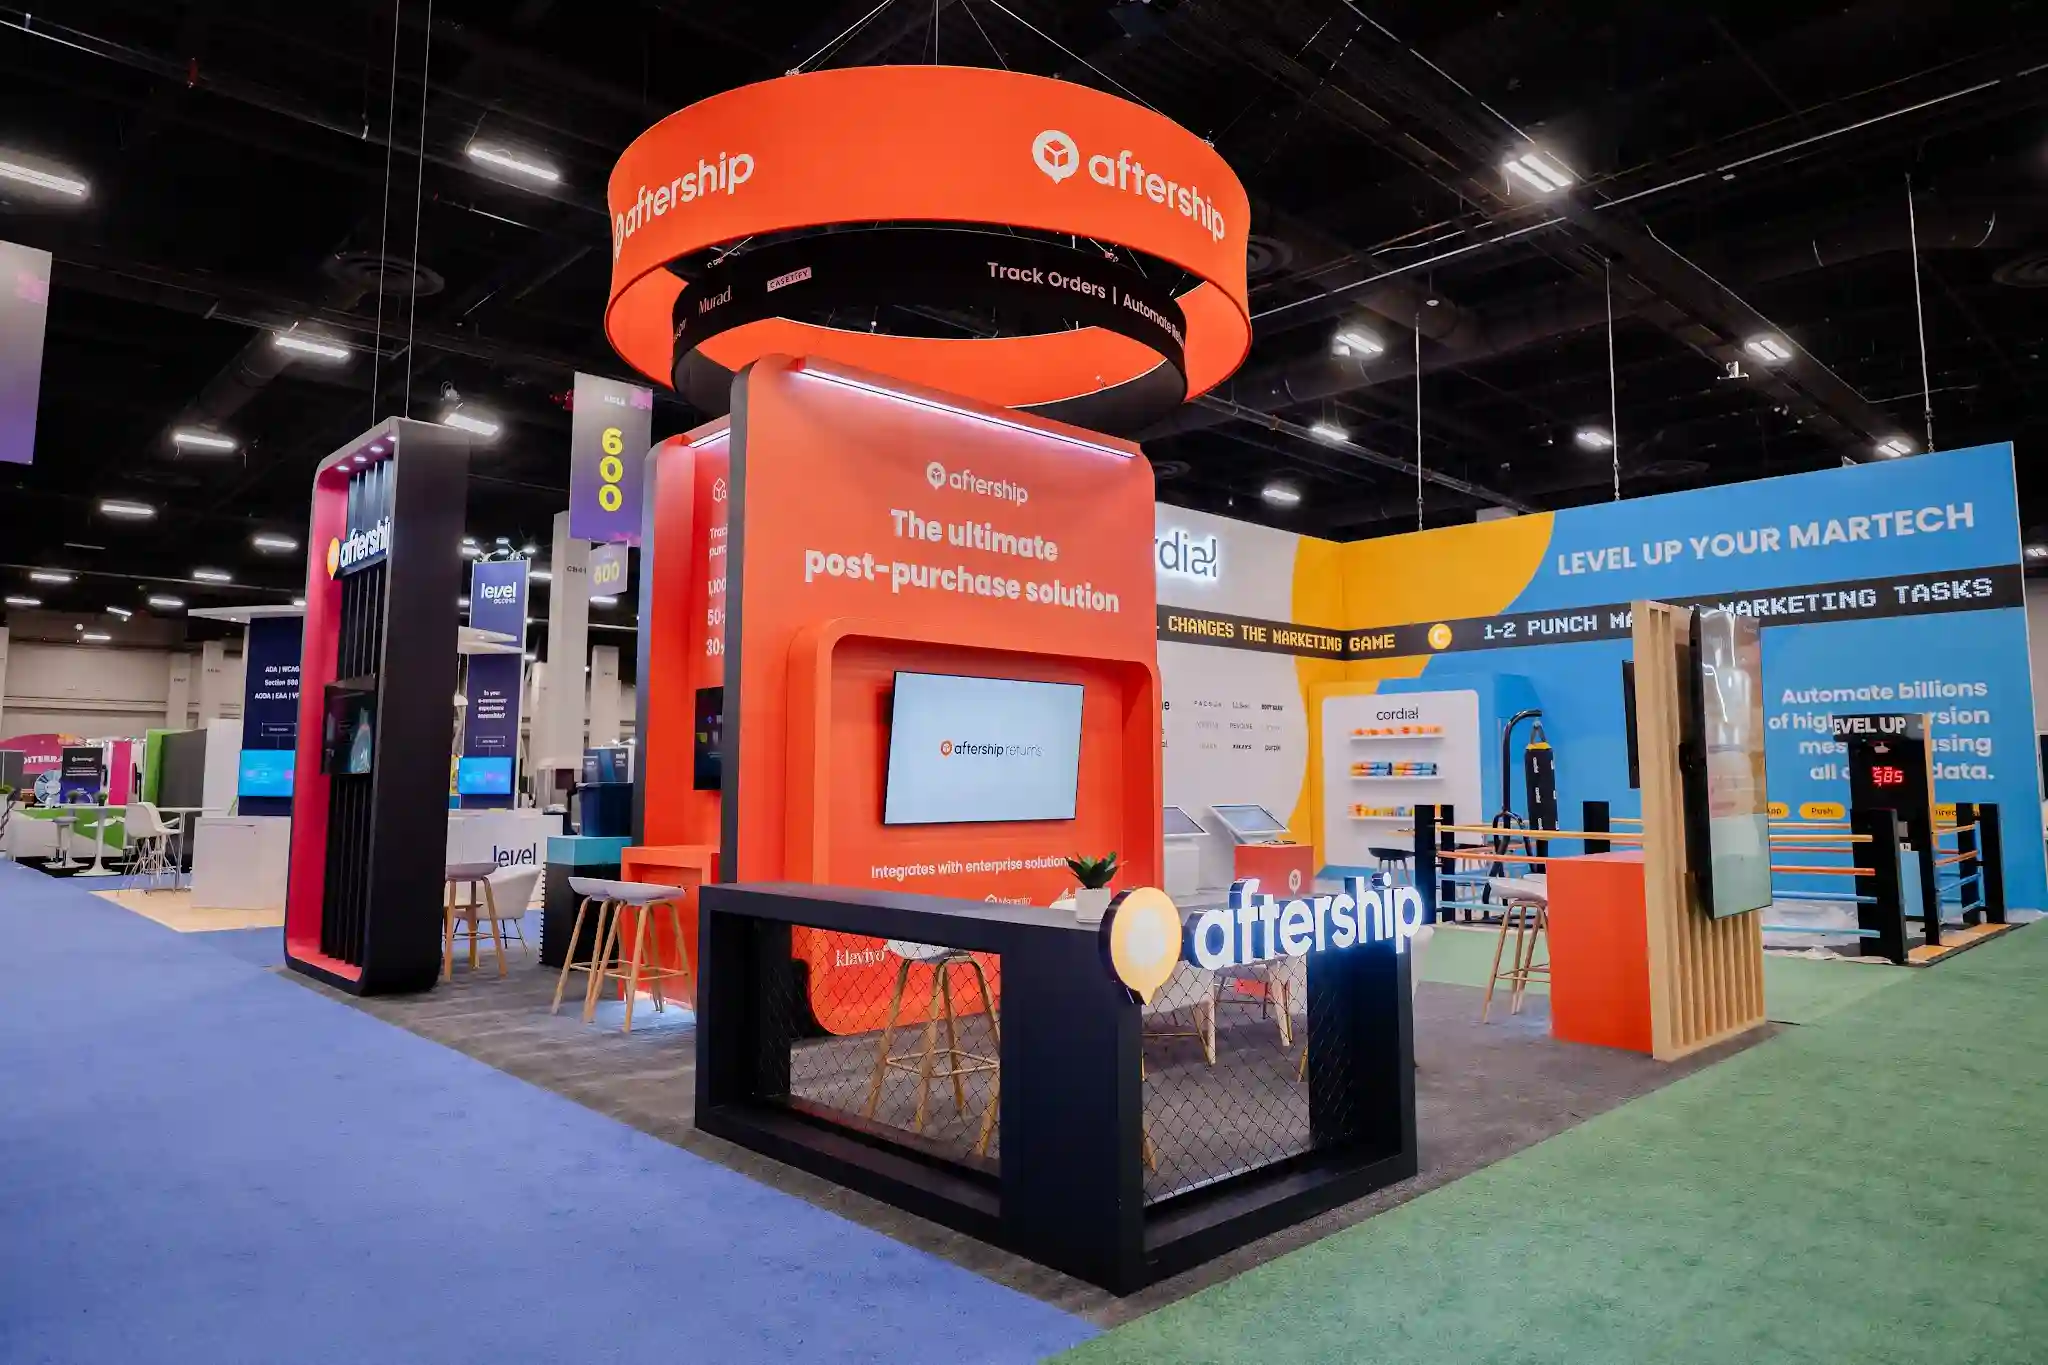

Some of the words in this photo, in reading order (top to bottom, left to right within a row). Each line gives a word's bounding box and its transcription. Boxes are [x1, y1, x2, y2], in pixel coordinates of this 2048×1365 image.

[624, 151, 755, 239] aftership
[1088, 150, 1226, 244] aftership
[987, 261, 1044, 285] Track
[1047, 271, 1106, 299] Orders
[1123, 293, 1172, 334] Automate
[598, 426, 624, 512] 600
[949, 467, 1029, 507] aftership
[890, 508, 943, 542] The
[948, 520, 1059, 562] ultimate
[1557, 546, 1637, 577] LEVEL
[1643, 539, 1683, 564] UP
[1690, 526, 1781, 561] YOUR
[1788, 501, 1975, 550] MARTECH
[1156, 531, 1217, 578] dial
[481, 581, 517, 599] level
[804, 548, 1021, 600] post-purchase
[1025, 579, 1120, 613] solution
[1719, 588, 1877, 617] MARKETING
[1893, 576, 1993, 603] TASKS
[1168, 615, 1234, 639] CHANGES
[1241, 624, 1267, 643] THE
[1272, 629, 1343, 651] MARKETING
[1349, 633, 1396, 651] GAME
[1483, 622, 1516, 640] 1-2
[1527, 615, 1598, 636] PUNCH
[264, 679, 286, 687] Section
[1781, 684, 1894, 705] Automate
[1898, 680, 1989, 700] billions
[1376, 706, 1419, 721] cordial
[1767, 711, 1789, 730] of
[1832, 717, 1876, 735] EVEL
[1879, 716, 1907, 734] UP
[954, 741, 1004, 758] aftership
[1810, 763, 1837, 780] all
[1811, 806, 1834, 816] Push
[493, 842, 537, 868] level
[871, 863, 935, 882] Integrates
[938, 860, 963, 874] with
[965, 856, 1023, 875] enterprise
[1192, 871, 1423, 970] aftership
[835, 947, 885, 968] klaviyo
